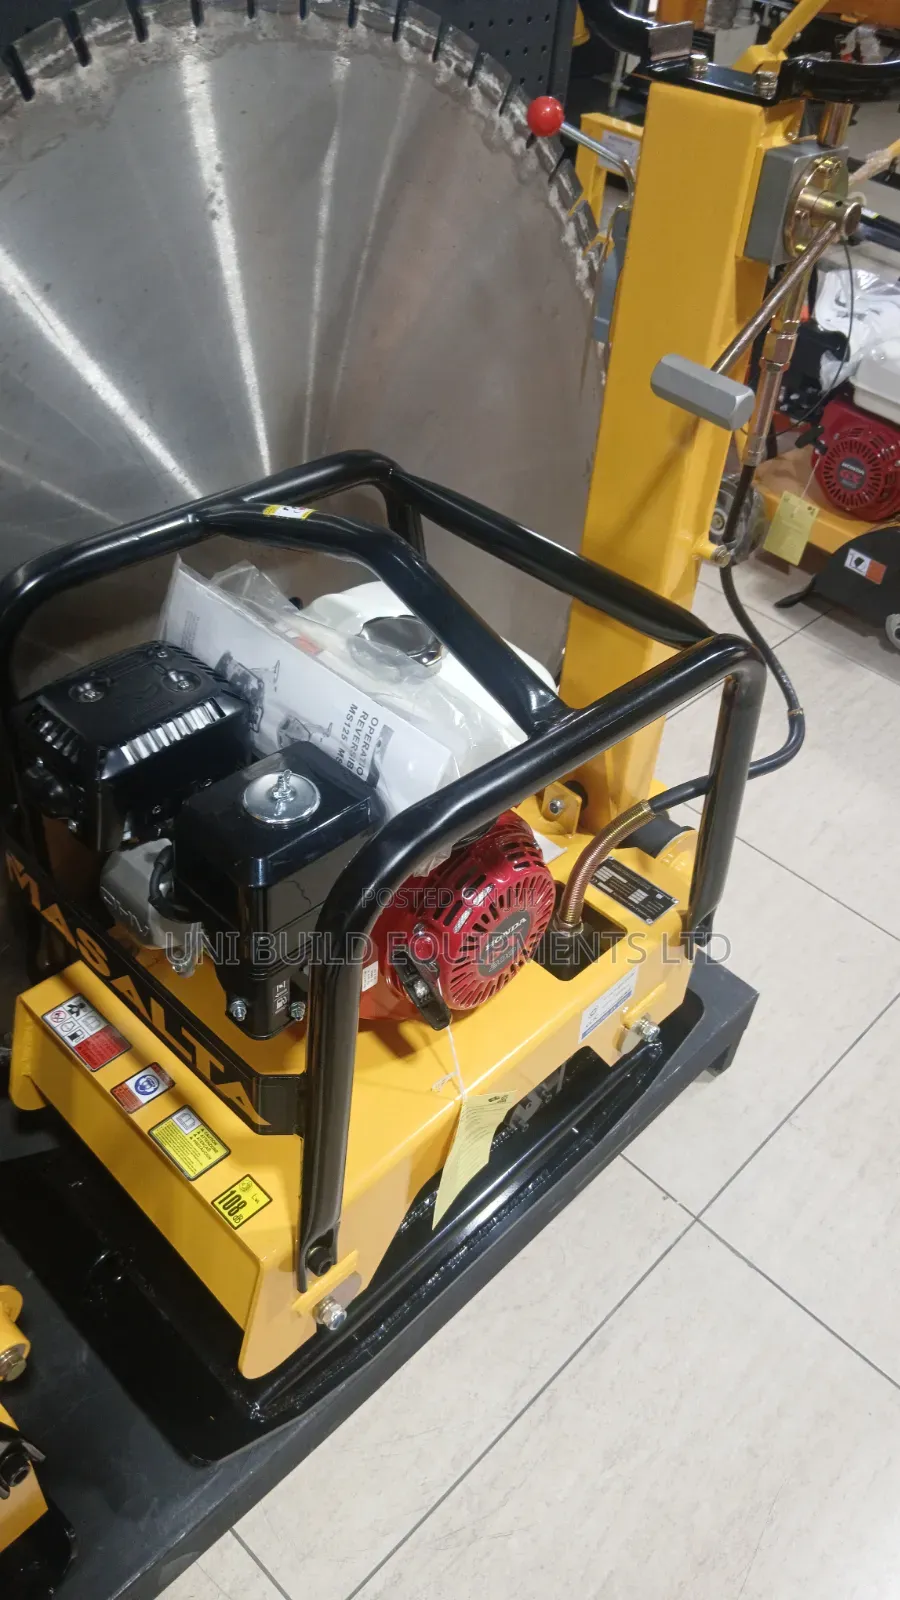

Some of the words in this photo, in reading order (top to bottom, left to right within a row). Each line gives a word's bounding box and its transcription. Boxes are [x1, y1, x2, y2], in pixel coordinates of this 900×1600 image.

[341, 703, 358, 741] MS125
[346, 710, 369, 770] REVERSIB
[356, 717, 379, 776] OPERATIO
[485, 917, 527, 951] HONDA
[5, 852, 272, 1126] MASALTA
[217, 1190, 247, 1217] 108
